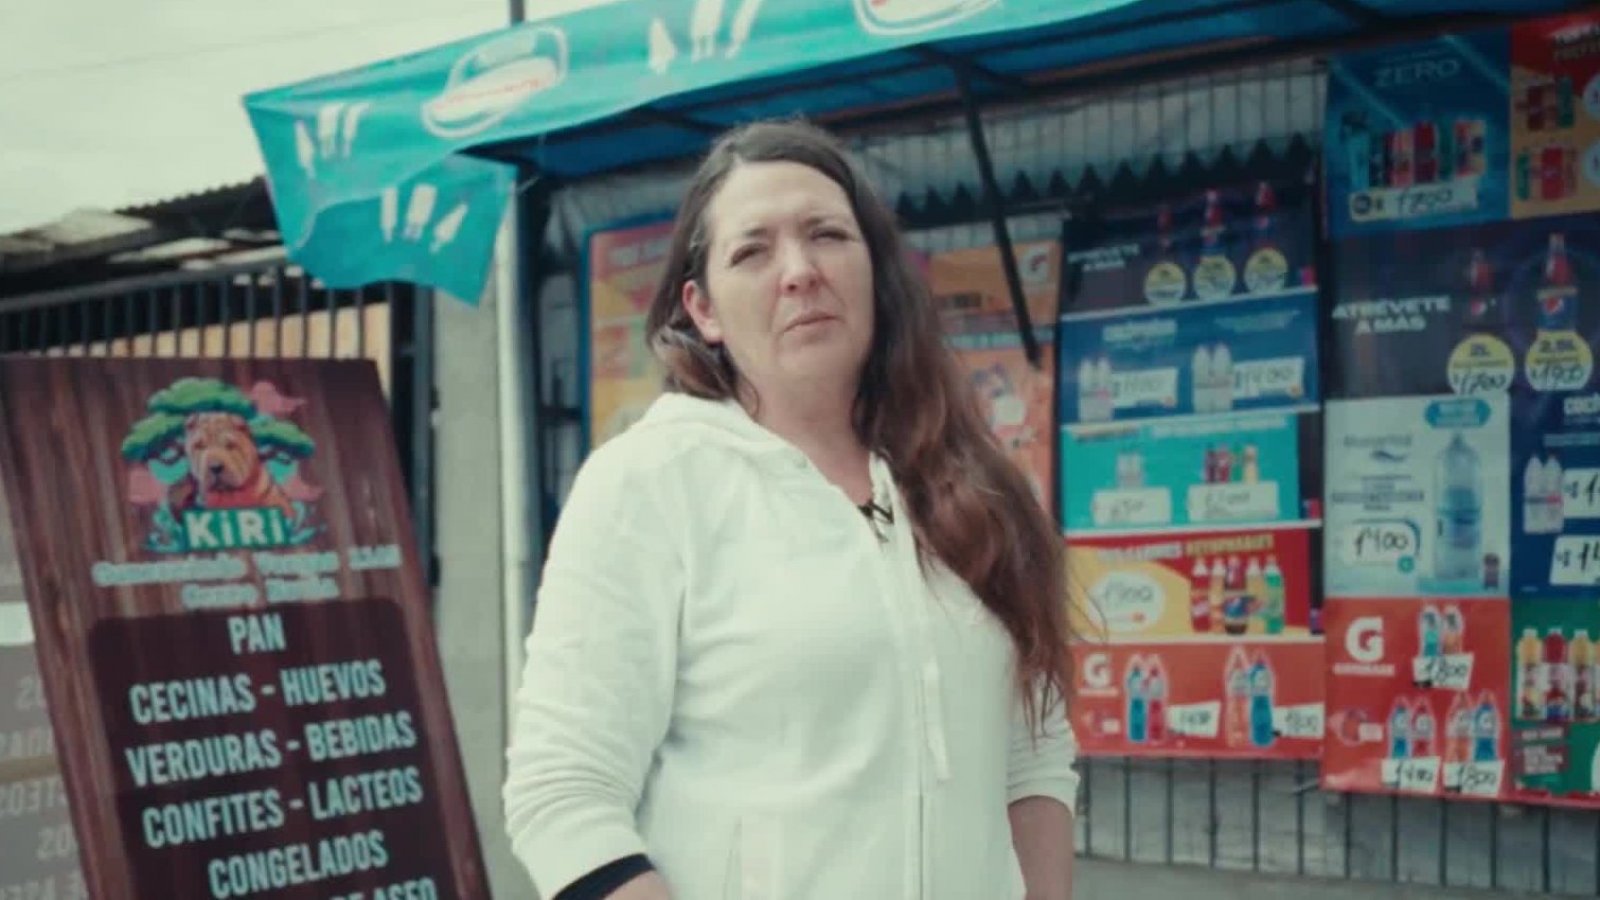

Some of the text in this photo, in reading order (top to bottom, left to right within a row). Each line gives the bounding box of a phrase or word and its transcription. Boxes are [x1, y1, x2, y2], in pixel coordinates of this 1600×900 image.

[1374, 57, 1460, 88] ZERO
[227, 613, 287, 654] PAN
[1344, 616, 1385, 663] G
[129, 673, 256, 725] CECINAS
[280, 659, 387, 706] HUEVOS
[125, 730, 282, 788] VERDURAS
[304, 711, 417, 762] BEBIDAS
[142, 788, 284, 849] CONFITES
[309, 766, 424, 820] LACTEOS
[208, 829, 389, 899] CONGELADOS
